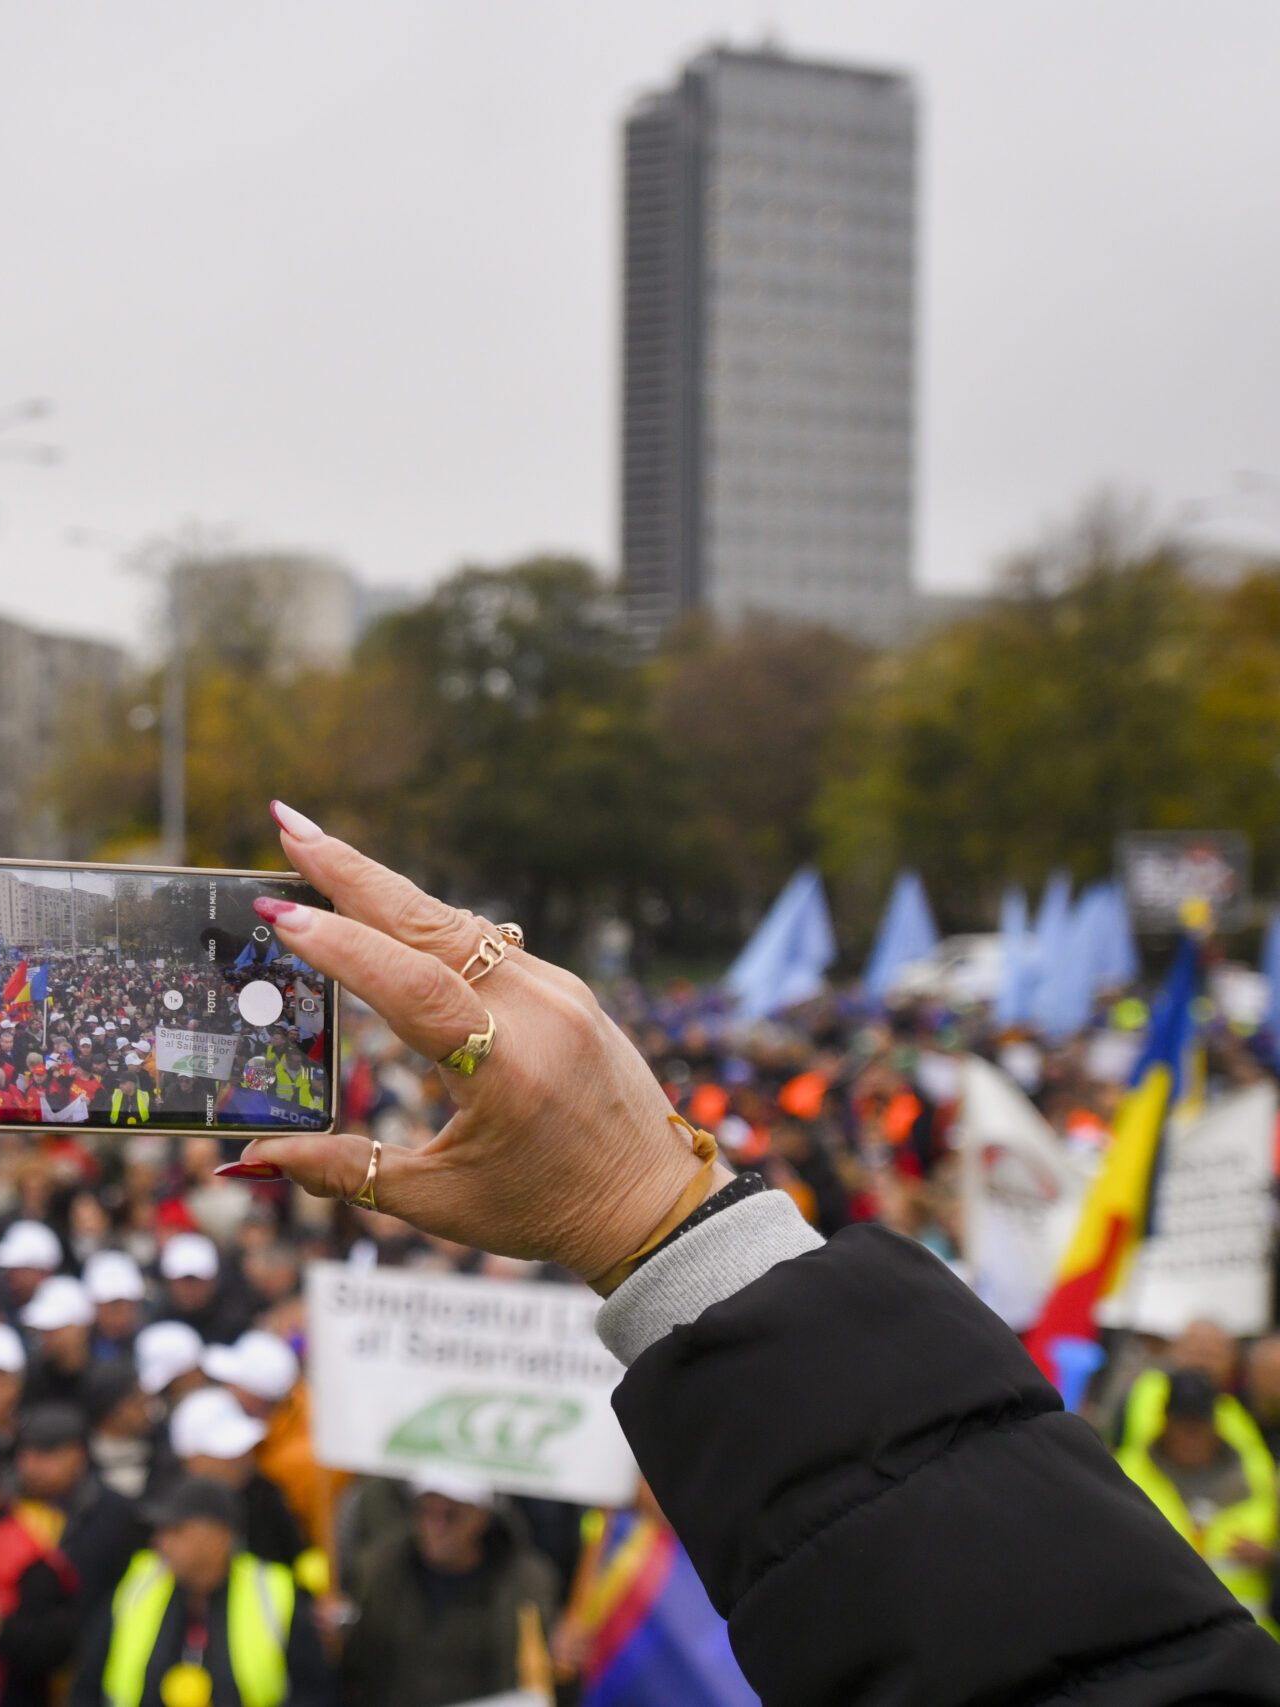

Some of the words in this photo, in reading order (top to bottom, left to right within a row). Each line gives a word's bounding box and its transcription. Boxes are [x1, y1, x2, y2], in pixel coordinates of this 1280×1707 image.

[209, 881, 217, 905] MULTE
[209, 905, 217, 920] MAI
[208, 939, 216, 962] VIDEO
[207, 990, 217, 1013] FOTO
[160, 1029, 208, 1044] Sindicatul
[211, 1035, 237, 1047] Liber
[165, 1040, 174, 1048] al
[205, 1094, 214, 1127] PORTRET
